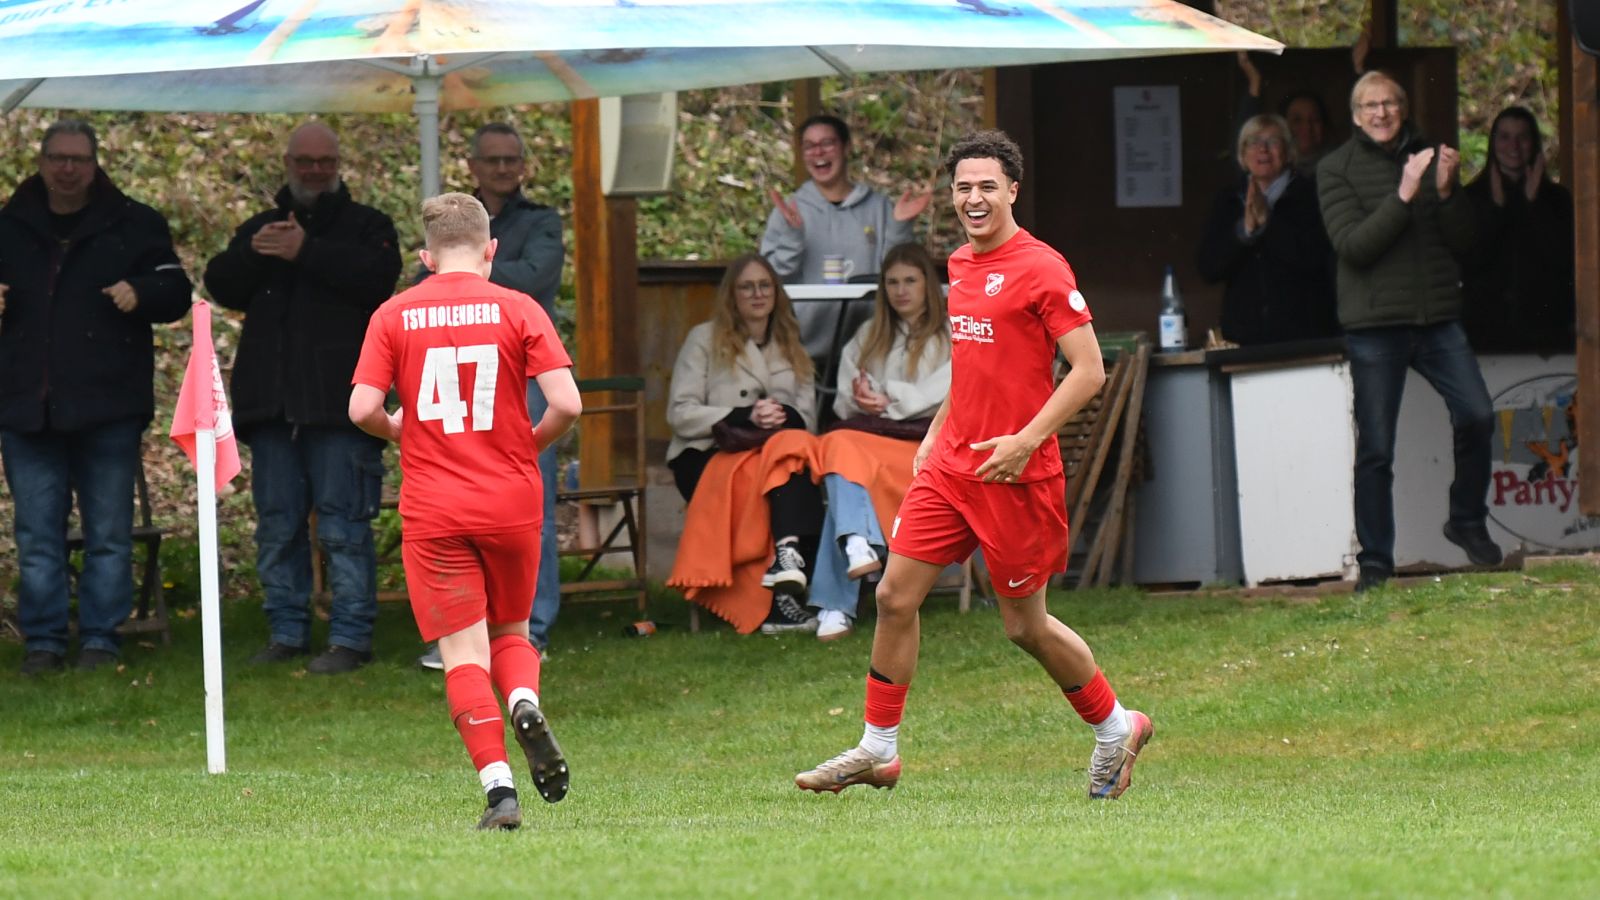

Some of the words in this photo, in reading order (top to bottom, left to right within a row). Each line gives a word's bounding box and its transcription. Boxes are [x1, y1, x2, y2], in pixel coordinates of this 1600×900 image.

[401, 307, 426, 331] TSV
[428, 303, 501, 328] HOLENBERG
[960, 315, 994, 336] Eilers
[416, 344, 499, 435] 47
[1492, 469, 1579, 513] Party
